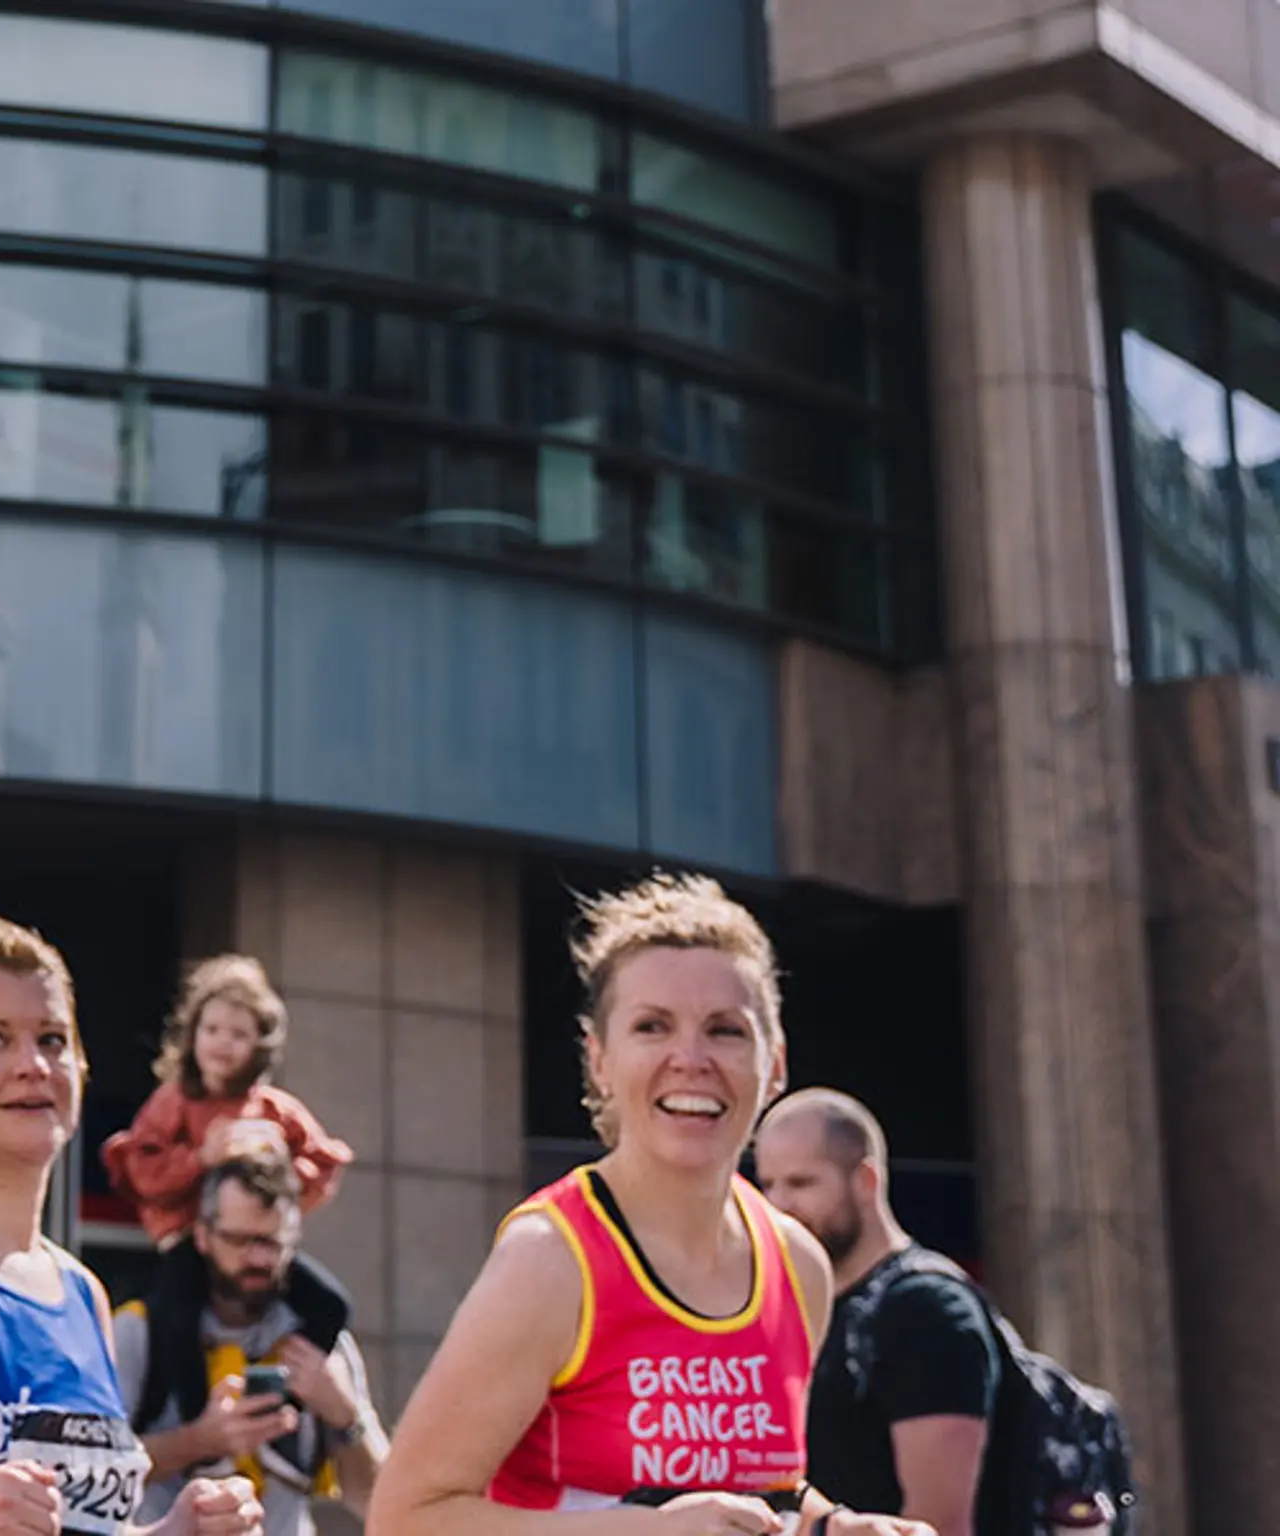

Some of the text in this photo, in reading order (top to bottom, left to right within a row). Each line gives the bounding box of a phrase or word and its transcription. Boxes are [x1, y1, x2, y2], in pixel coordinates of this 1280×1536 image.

[628, 1354, 769, 1398] BREAST
[628, 1401, 786, 1443] CANCER
[631, 1444, 731, 1485] NOW
